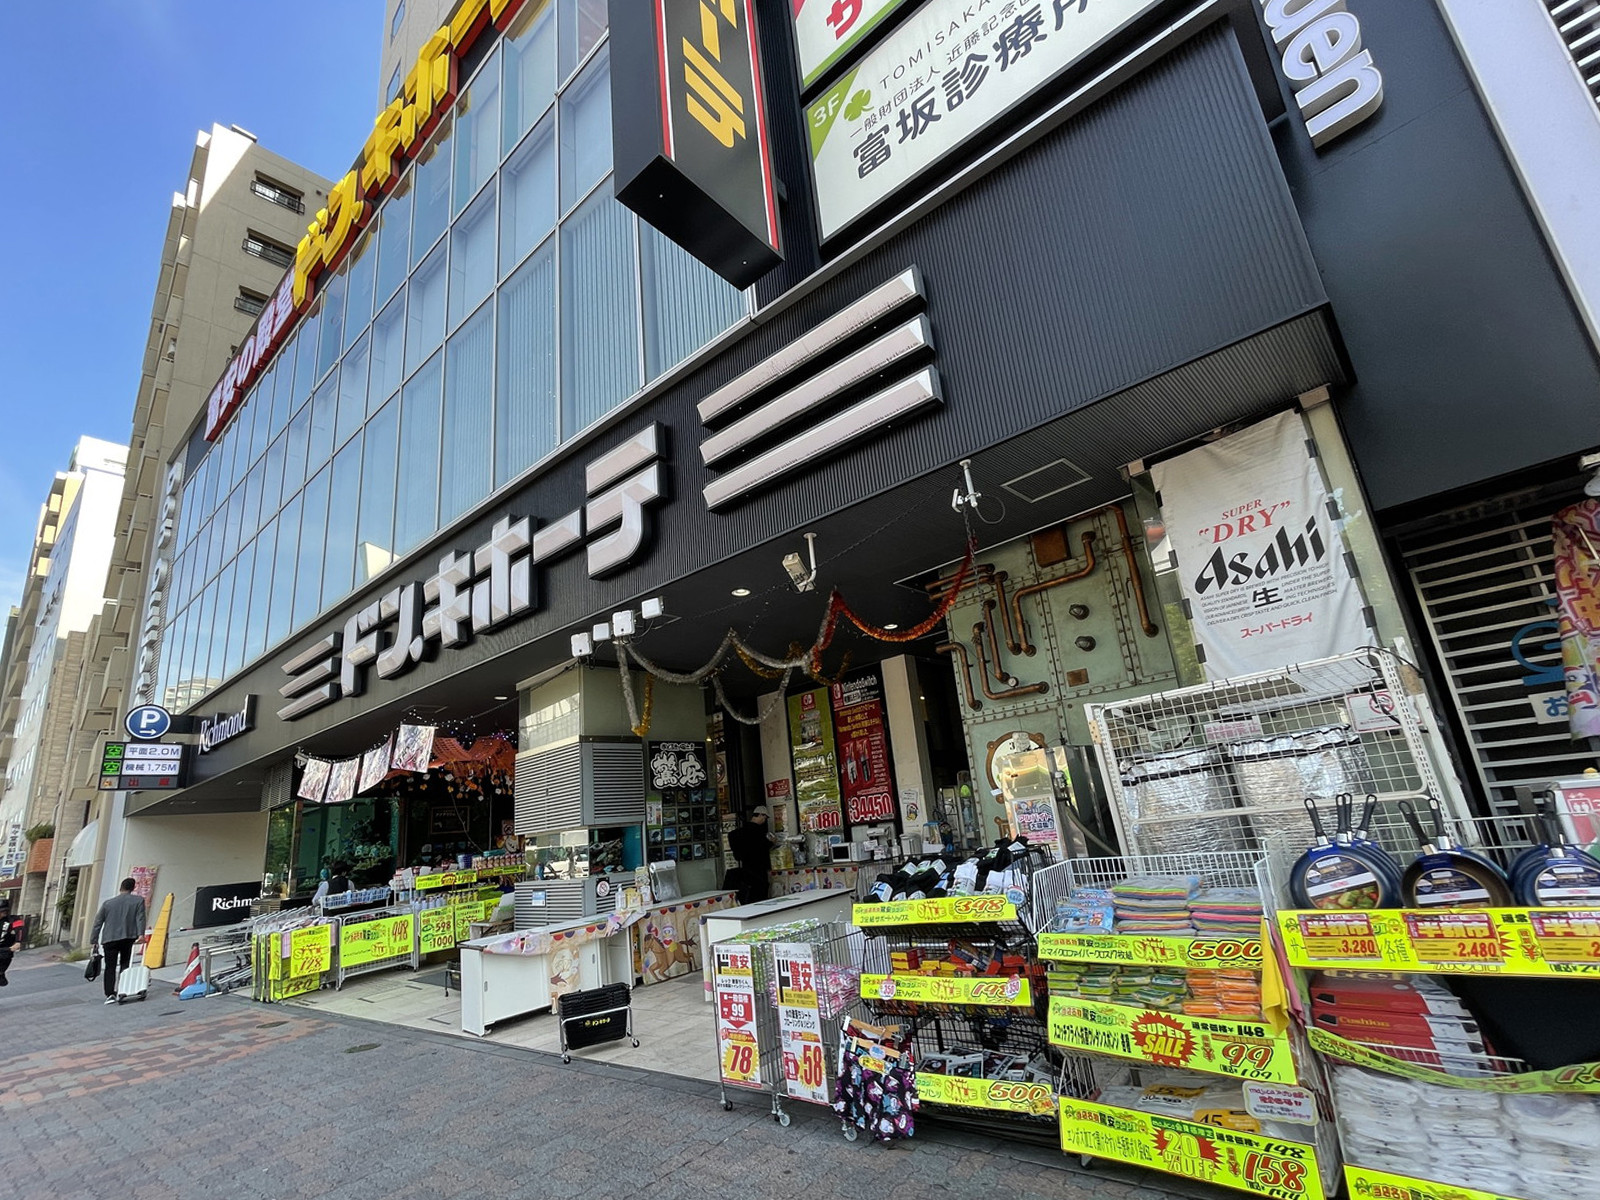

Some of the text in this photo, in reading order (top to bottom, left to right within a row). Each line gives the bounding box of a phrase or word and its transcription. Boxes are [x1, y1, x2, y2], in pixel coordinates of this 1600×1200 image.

[850, 0, 1030, 138] 一般財団法人 近藤記念
[1261, 0, 1382, 140] uen
[813, 92, 841, 128] 3F
[1221, 499, 1262, 520] SUPER
[1194, 515, 1326, 594] Asahi
[1252, 587, 1283, 608] 生
[1240, 612, 1313, 638] スーパードライ
[140, 710, 161, 728] P
[198, 693, 252, 756] Richmond
[651, 750, 706, 789] 驚安
[1188, 940, 1262, 961] 500
[1457, 942, 1497, 958] 2,480
[731, 1003, 745, 1018] 99
[1137, 1023, 1186, 1039] SUPER
[1237, 1025, 1265, 1037] 148
[730, 1045, 753, 1075] 78
[1144, 1034, 1185, 1059] SALE
[1222, 1042, 1274, 1071] 99
[803, 1044, 822, 1087] 58
[989, 1081, 1049, 1102] 500
[1163, 1130, 1200, 1159] 20
[1264, 1142, 1306, 1159] 198
[1164, 1151, 1215, 1181] %OFF
[1244, 1150, 1308, 1193] 158
